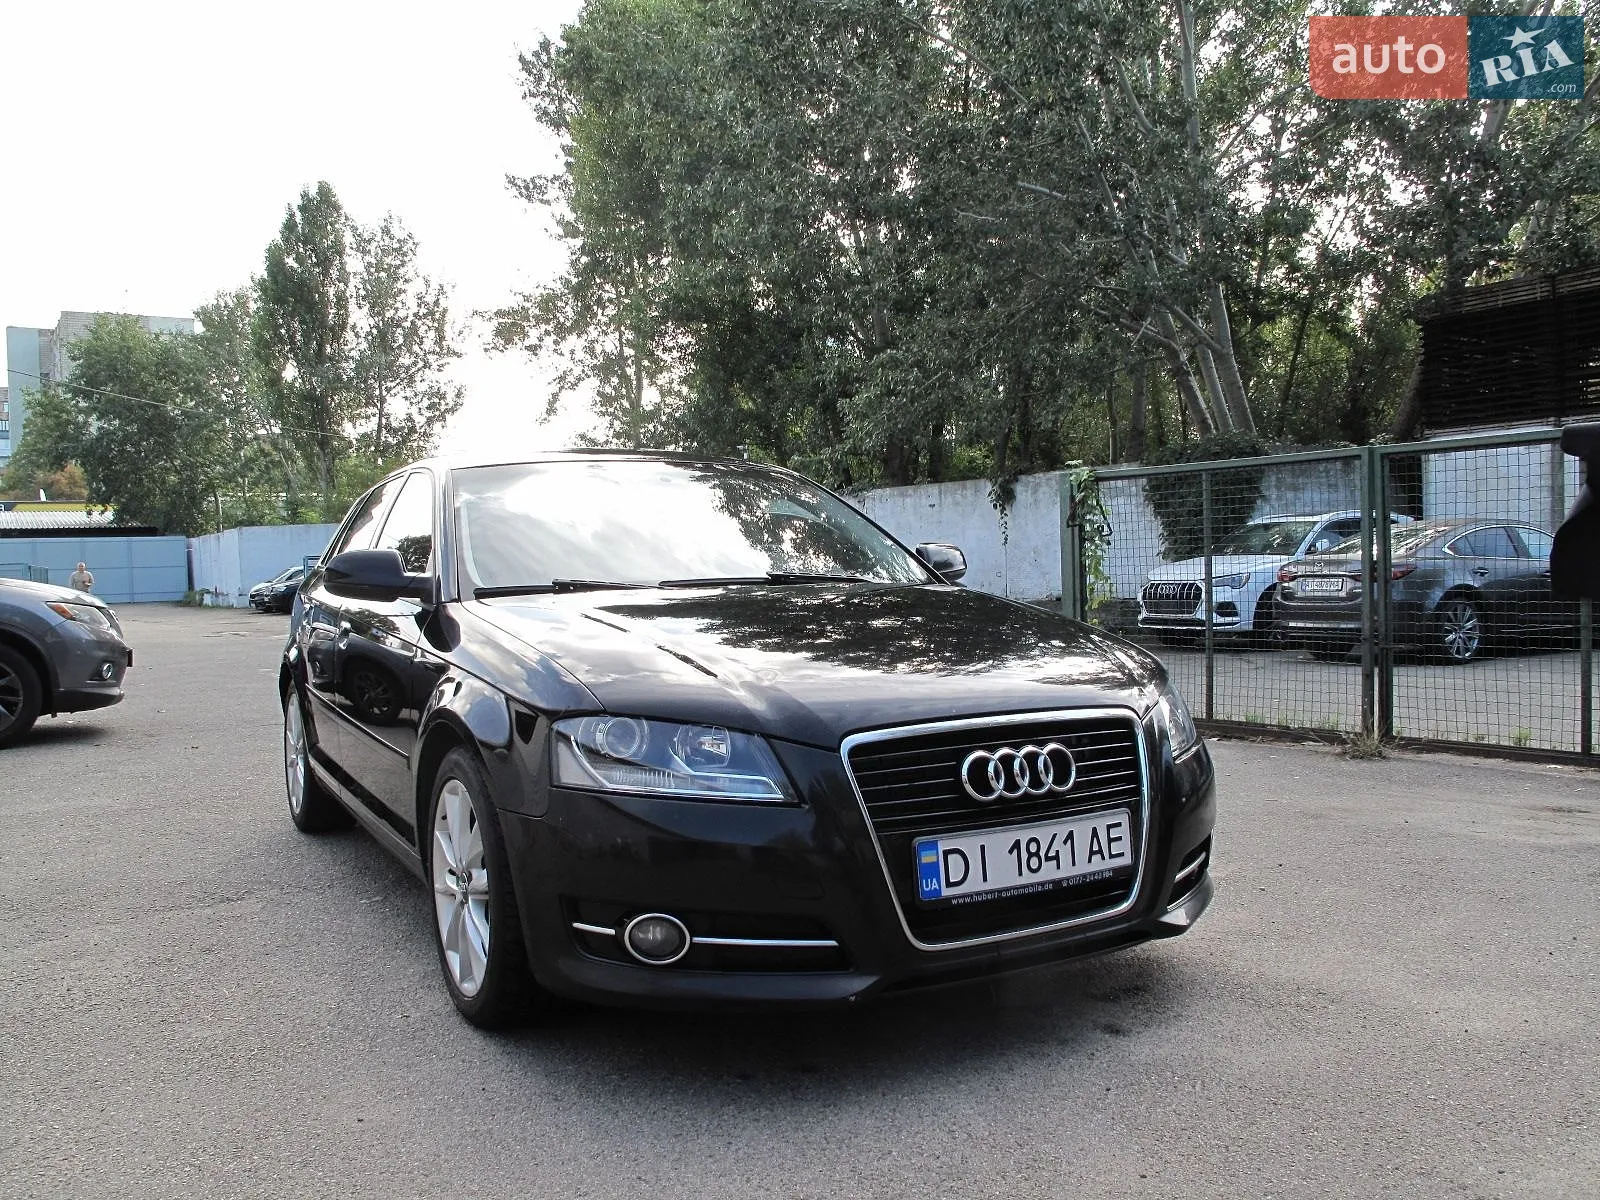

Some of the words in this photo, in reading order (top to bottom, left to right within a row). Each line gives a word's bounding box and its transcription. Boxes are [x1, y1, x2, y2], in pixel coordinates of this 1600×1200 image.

[942, 844, 988, 889] DI
[1008, 829, 1077, 877] 1841
[1087, 821, 1125, 864] AE
[922, 879, 940, 892] UA
[951, 883, 1053, 905] www.hubert-automobile.de
